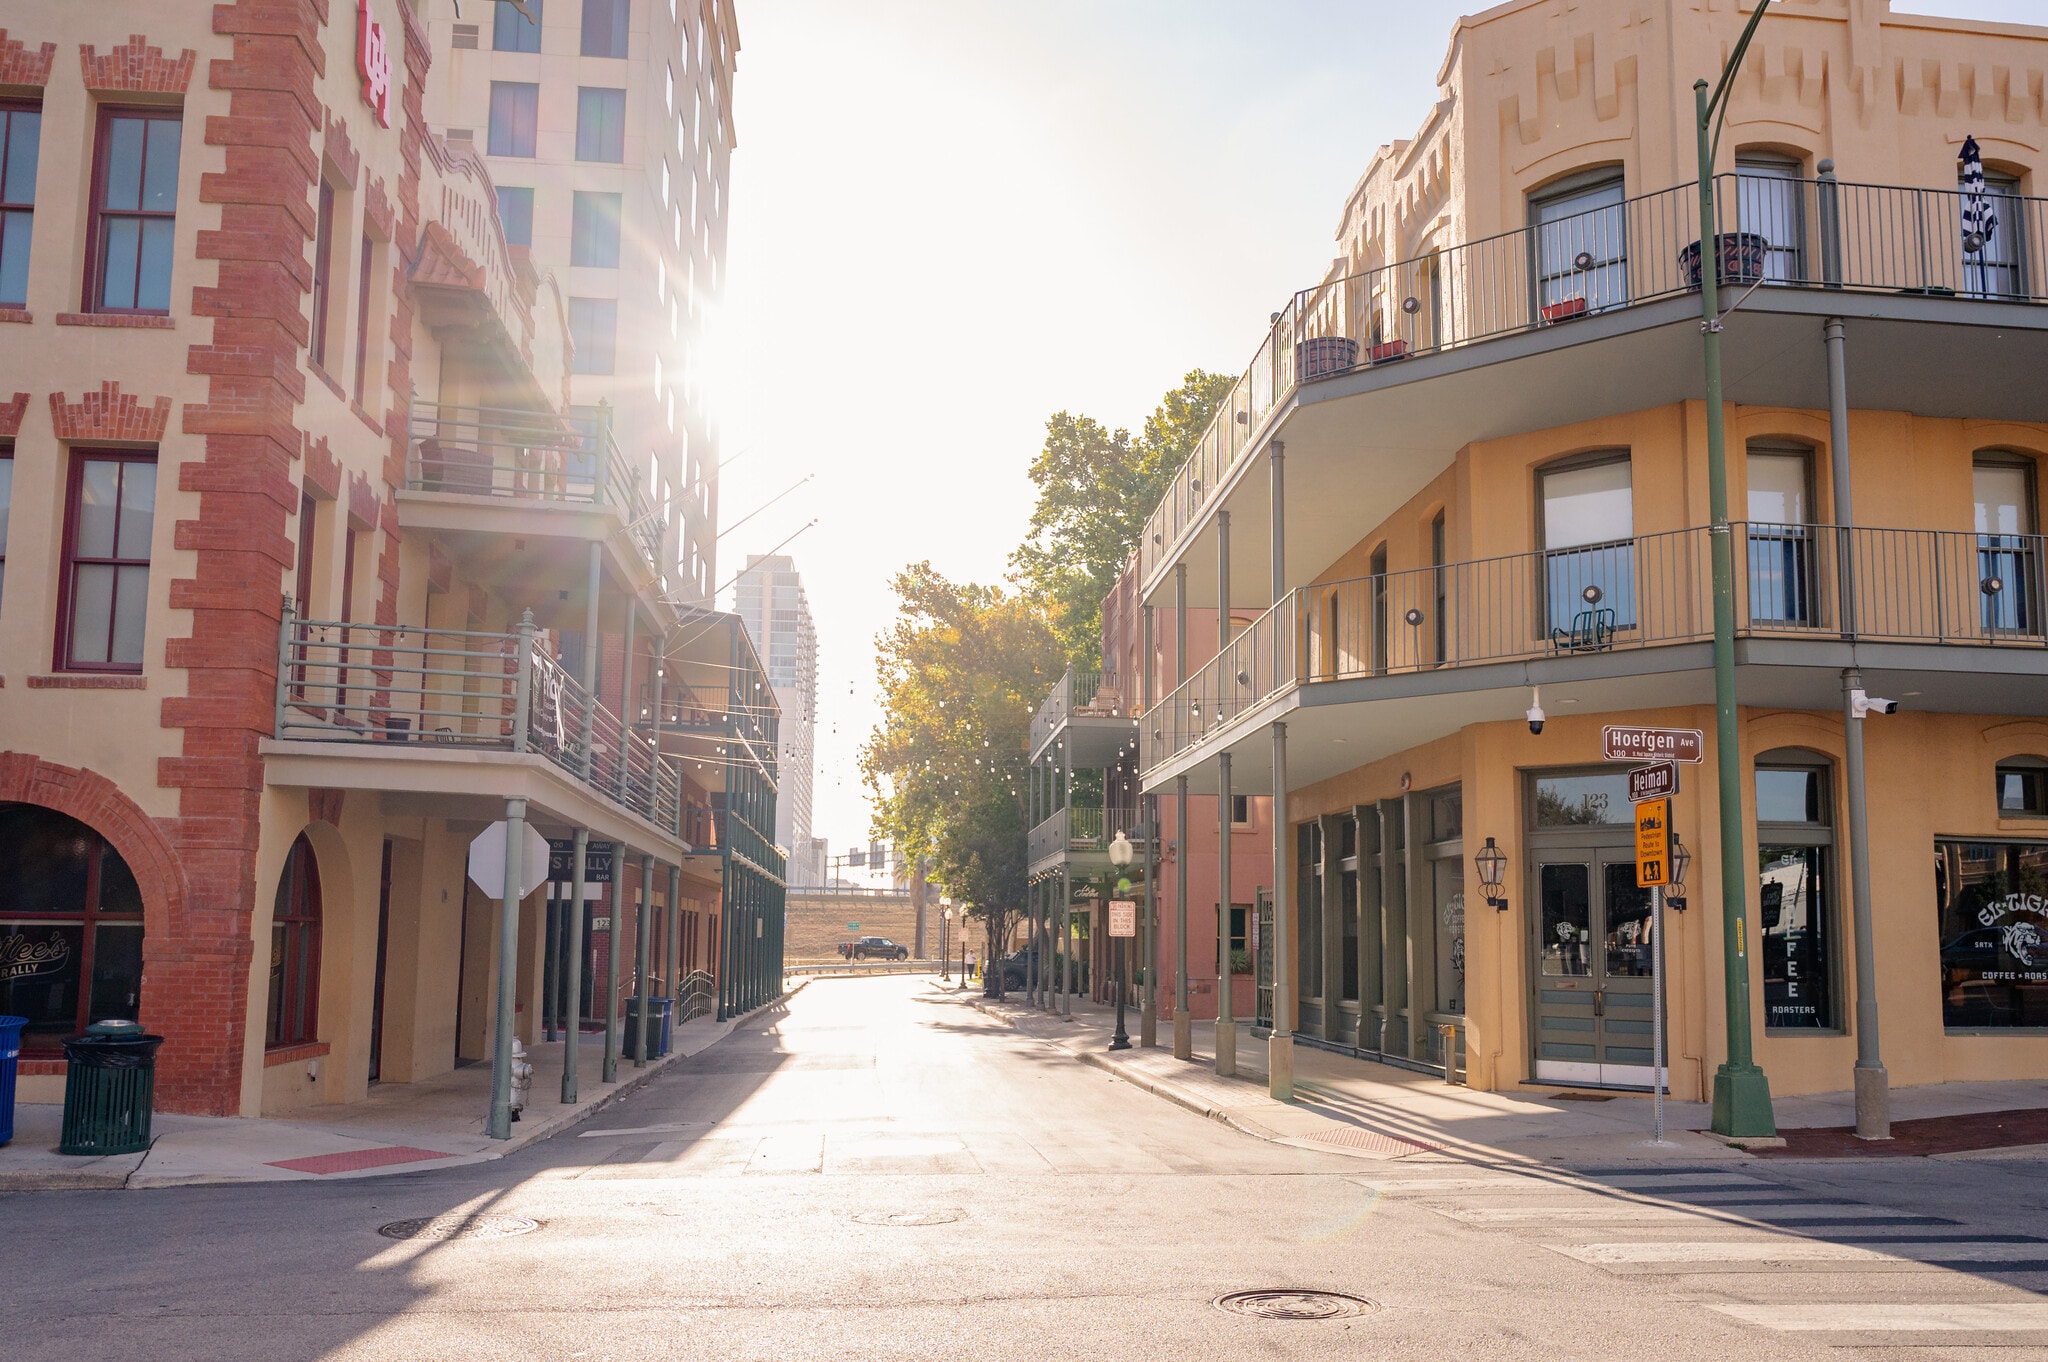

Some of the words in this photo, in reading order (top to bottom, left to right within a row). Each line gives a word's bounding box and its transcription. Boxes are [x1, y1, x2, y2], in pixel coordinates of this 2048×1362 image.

[1612, 731, 1674, 751] Hoefgen
[1680, 738, 1694, 747] Ave
[1613, 749, 1626, 757] 100
[1634, 770, 1667, 791] Heiman
[1582, 793, 1608, 810] 123
[1641, 832, 1661, 840] Pedestrian
[1641, 849, 1662, 857] Downtown
[596, 873, 610, 881] BAR
[1978, 901, 2005, 926] EL
[1974, 941, 1993, 949] SATX
[2, 963, 38, 978] RALLY
[1982, 971, 2016, 980] COFFEE
[1772, 1006, 1816, 1014] ROASTERS
